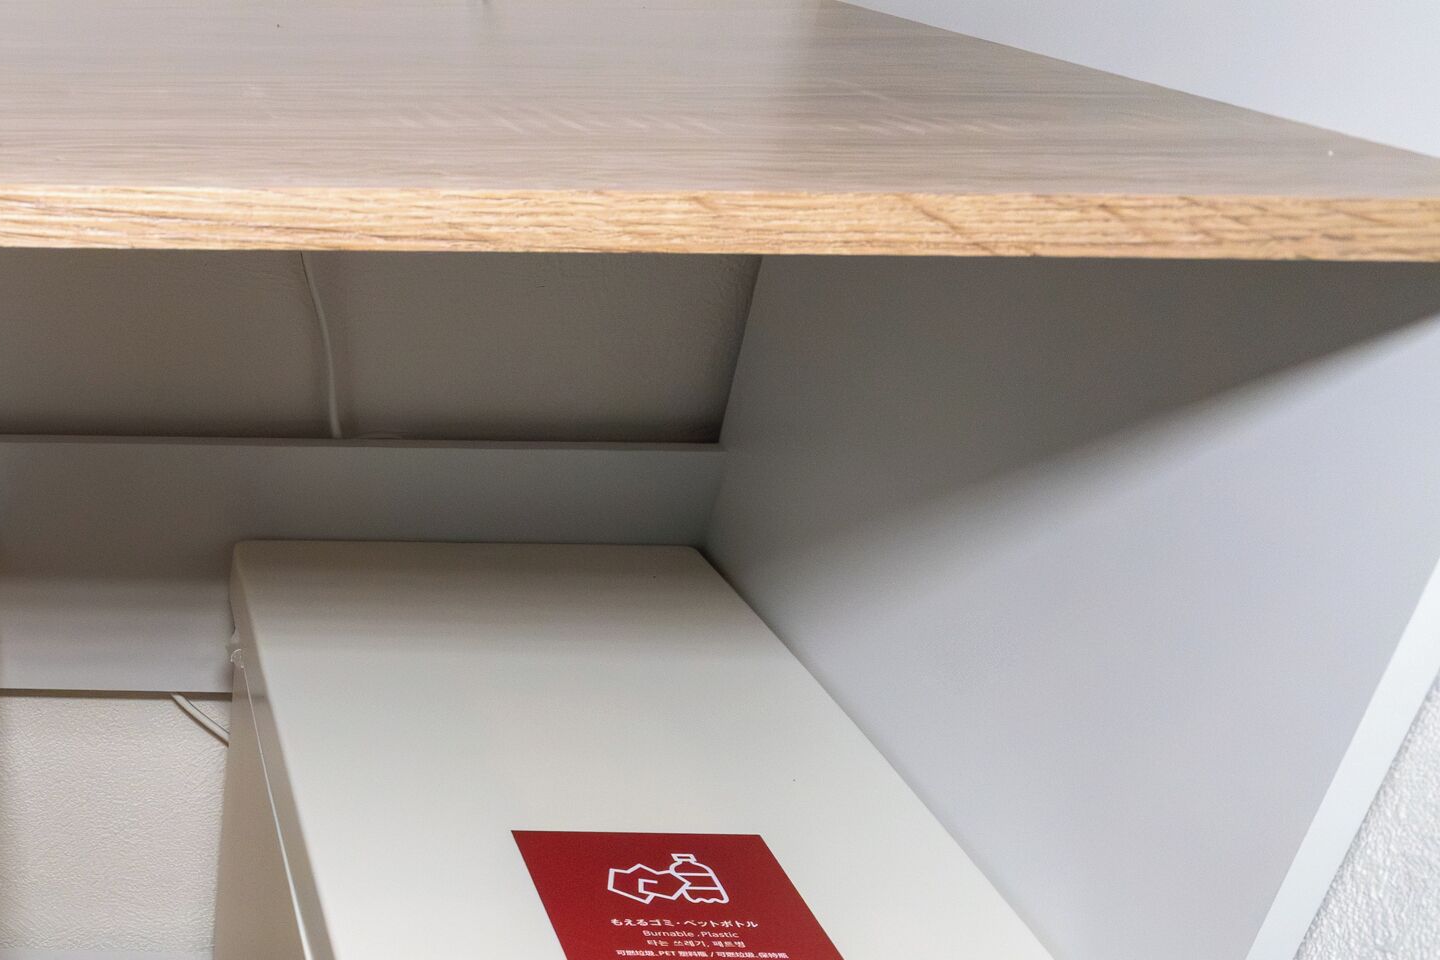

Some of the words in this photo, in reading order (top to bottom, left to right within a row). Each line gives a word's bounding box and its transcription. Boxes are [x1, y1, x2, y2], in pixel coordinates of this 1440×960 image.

[610, 918, 759, 928] もえるゴミ・ペットボトル
[646, 939, 669, 947] 타는
[711, 940, 746, 948] 페트병
